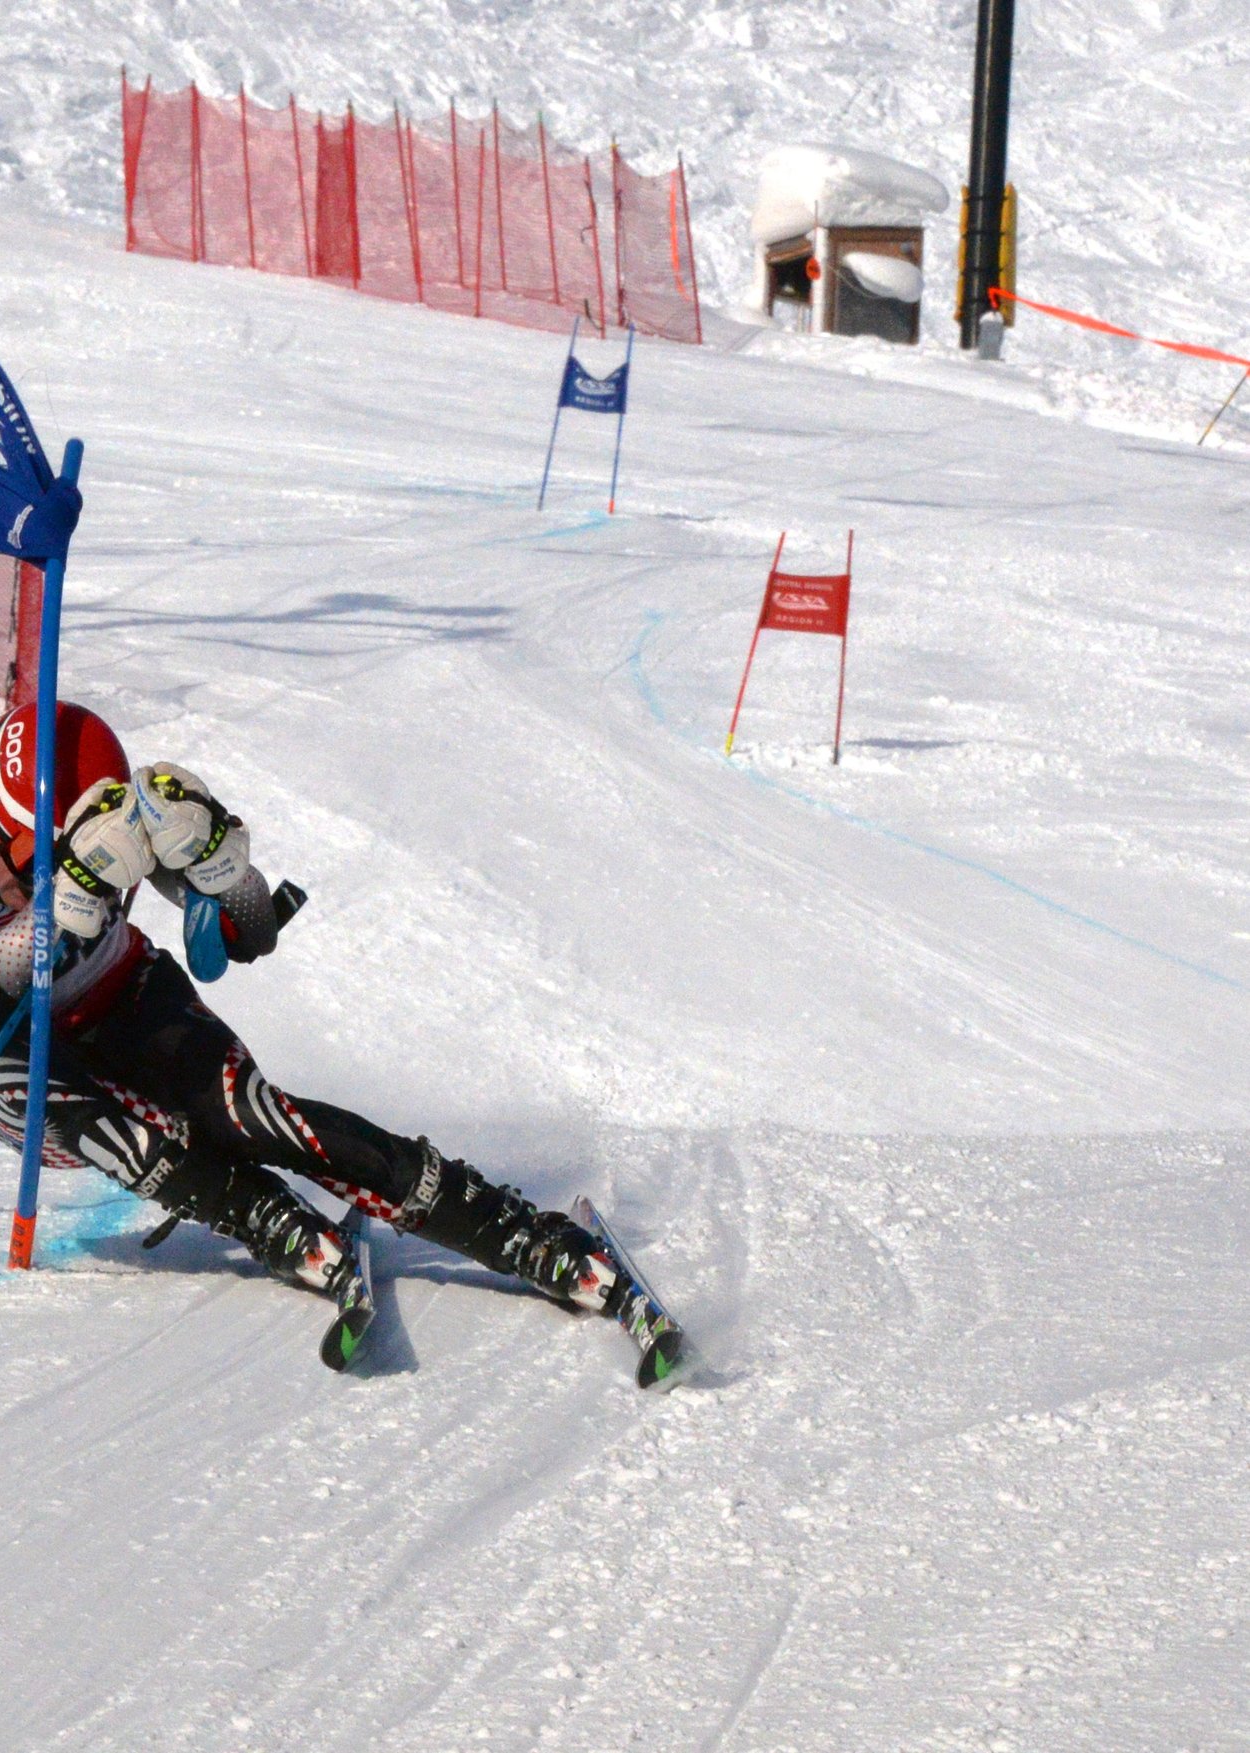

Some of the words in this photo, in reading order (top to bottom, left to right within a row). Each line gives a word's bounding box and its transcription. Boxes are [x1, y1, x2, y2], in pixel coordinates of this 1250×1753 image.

[6, 721, 25, 778] POC
[202, 823, 225, 859] LEKI
[63, 859, 97, 888] LEKI
[32, 927, 49, 989] SPM
